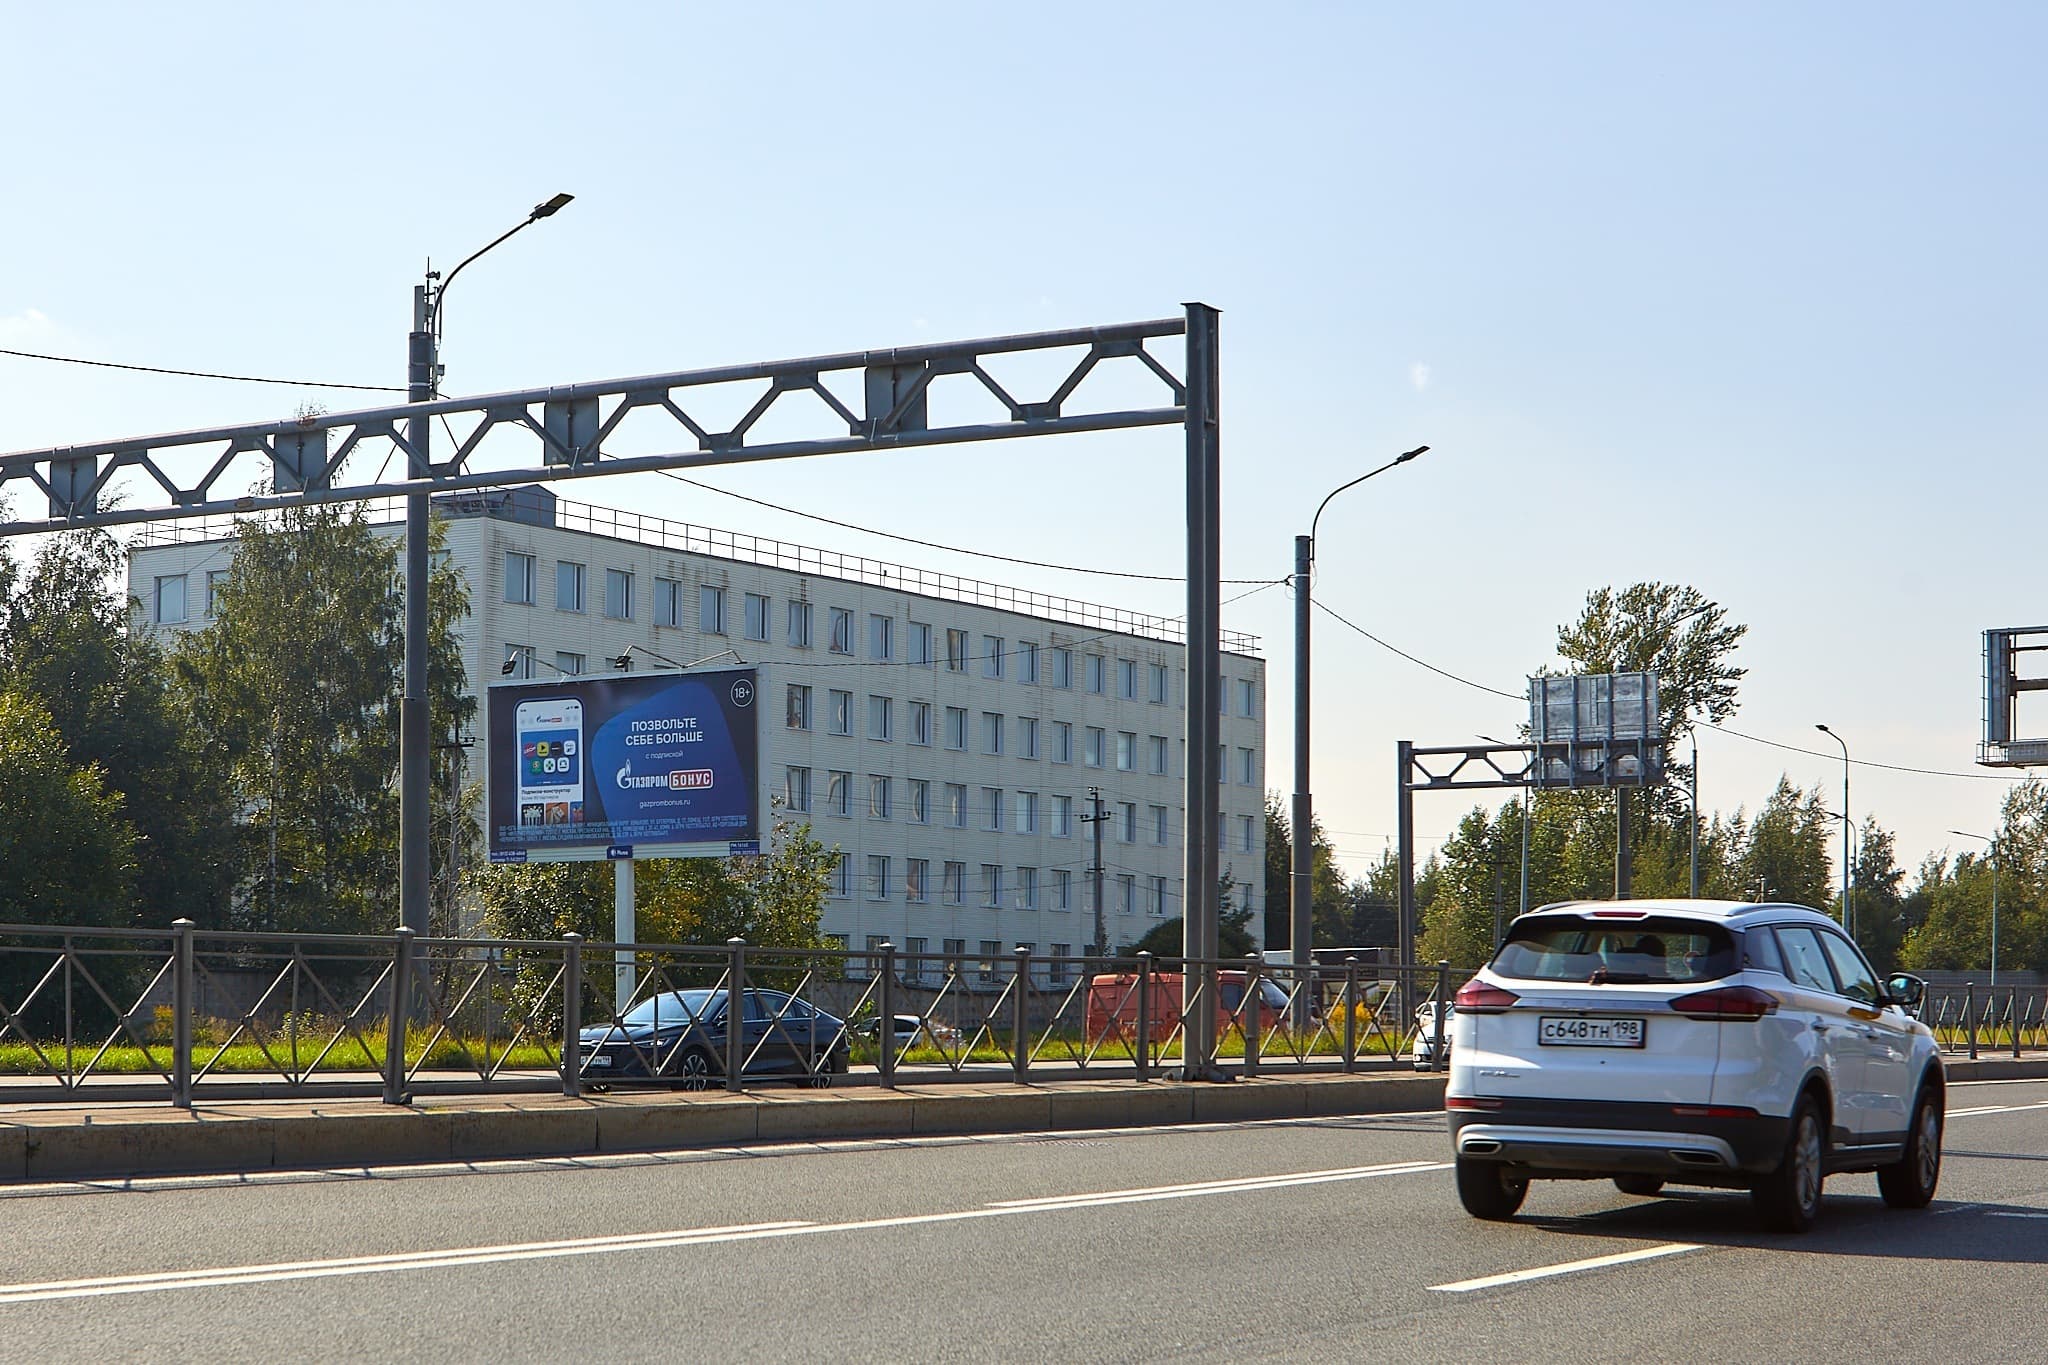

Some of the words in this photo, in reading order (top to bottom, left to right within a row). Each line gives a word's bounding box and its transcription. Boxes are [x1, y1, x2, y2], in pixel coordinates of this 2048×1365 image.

[734, 687, 750, 699] 18+
[631, 717, 697, 732] ПОЗВОЛЬТЕ
[625, 734, 653, 746] СЕБЕ
[656, 731, 703, 745] БОЛЬШЕ
[650, 750, 683, 759] подпиской
[672, 773, 710, 786] БОНУС
[639, 799, 691, 809] gazprombonus.ru
[1613, 1021, 1638, 1035] 198
